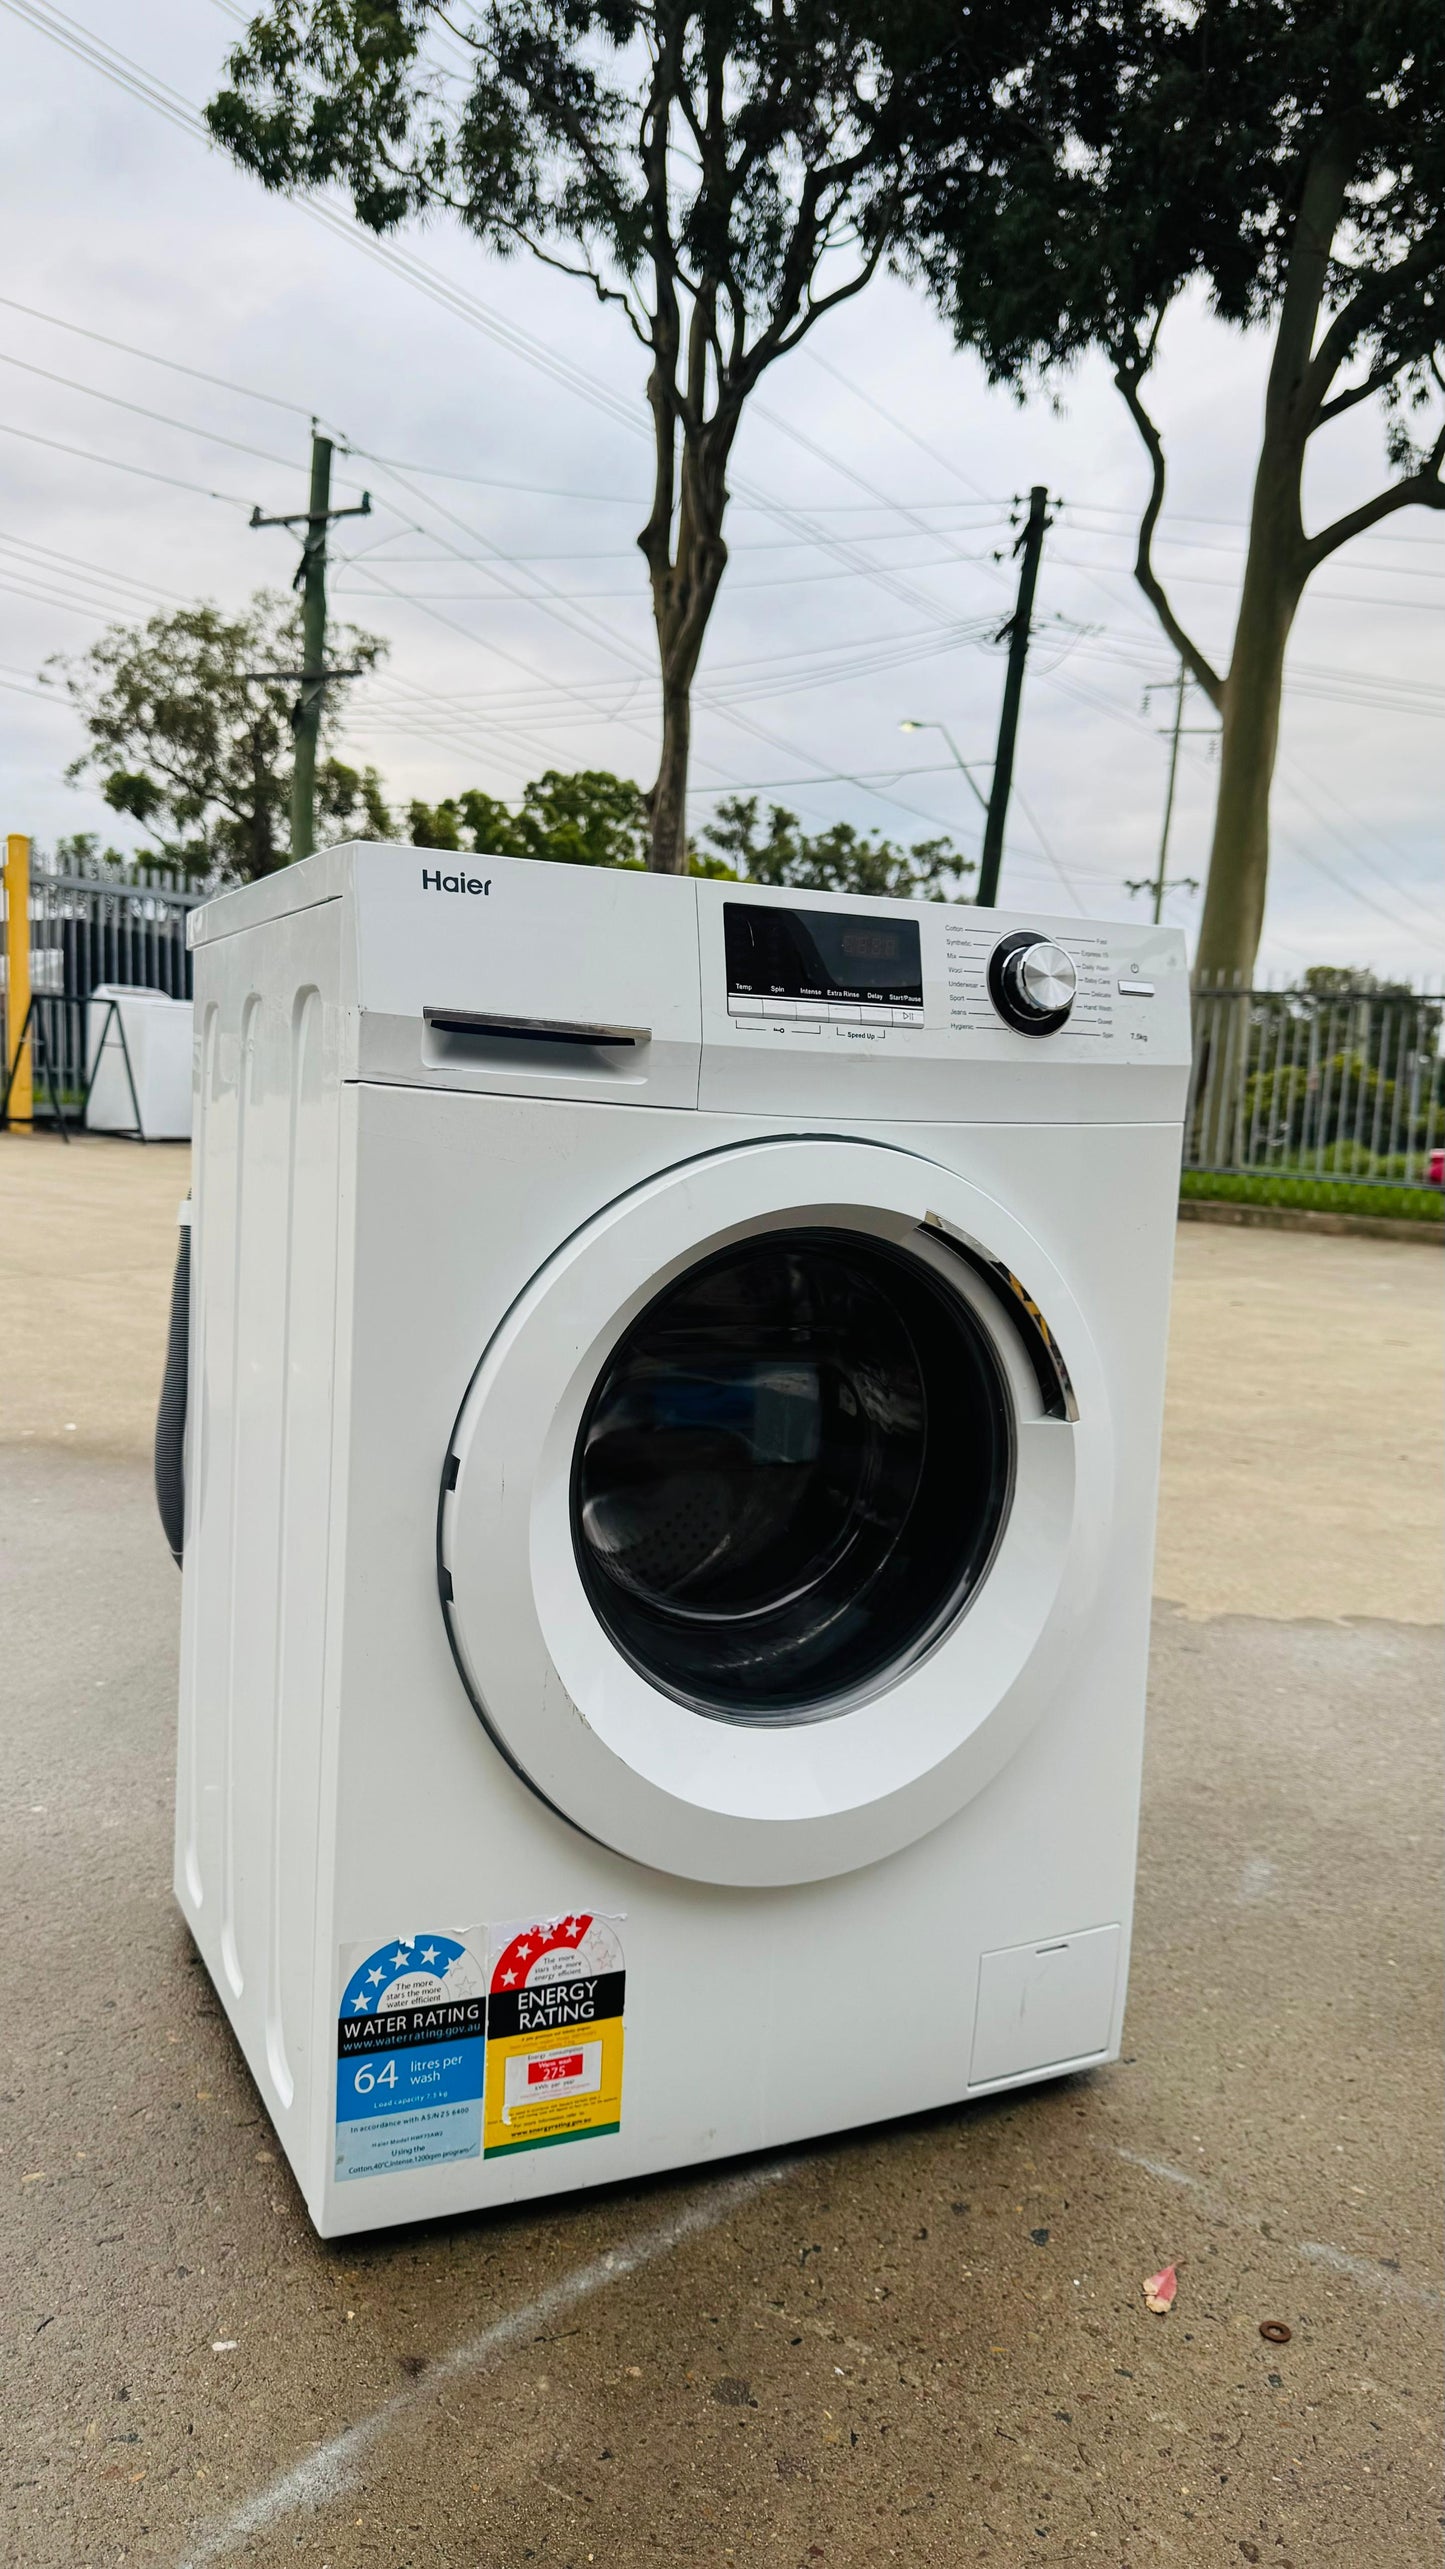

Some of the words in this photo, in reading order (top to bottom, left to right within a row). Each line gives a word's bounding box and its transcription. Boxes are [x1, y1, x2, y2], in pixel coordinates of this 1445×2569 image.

[422, 869, 492, 896] Haier
[946, 939, 972, 947] Synthetic
[735, 983, 752, 991] Temp
[770, 985, 785, 993] Spin
[800, 987, 822, 995] Intense
[827, 989, 842, 997] Extra
[867, 992, 883, 1001] Delay
[889, 993, 921, 1002] Start/Pause
[950, 1023, 974, 1031] Hygienic
[847, 1031, 866, 1040] Speed
[866, 1032, 875, 1041] Up
[544, 1957, 555, 1965] The
[558, 1954, 574, 1962] more
[534, 1973, 555, 1981] energy
[558, 1968, 581, 1977] efficient
[535, 1966, 549, 1974] stars
[395, 1983, 411, 1991] The
[413, 1980, 433, 1988] more
[387, 1992, 405, 2000] stars
[407, 1990, 420, 1998] the
[422, 1987, 441, 1995] more
[518, 1980, 598, 2011] ENERGY
[387, 2000, 408, 2008] water
[410, 1994, 441, 2005] efficient
[344, 2016, 406, 2039] WATER
[413, 2004, 479, 2029] RATING
[520, 2001, 595, 2030] RATING
[343, 2022, 481, 2051] www.waterrating.gov.au
[410, 2059, 440, 2073] litres
[443, 2055, 463, 2070] per
[354, 2059, 399, 2094] 64
[410, 2071, 441, 2085] wash
[543, 2065, 566, 2080] 275
[374, 2099, 392, 2109] Load
[394, 2094, 424, 2106] capacity
[360, 2120, 401, 2132] accordance
[403, 2116, 419, 2125] with
[391, 2147, 412, 2157] Using
[413, 2144, 426, 2153] the
